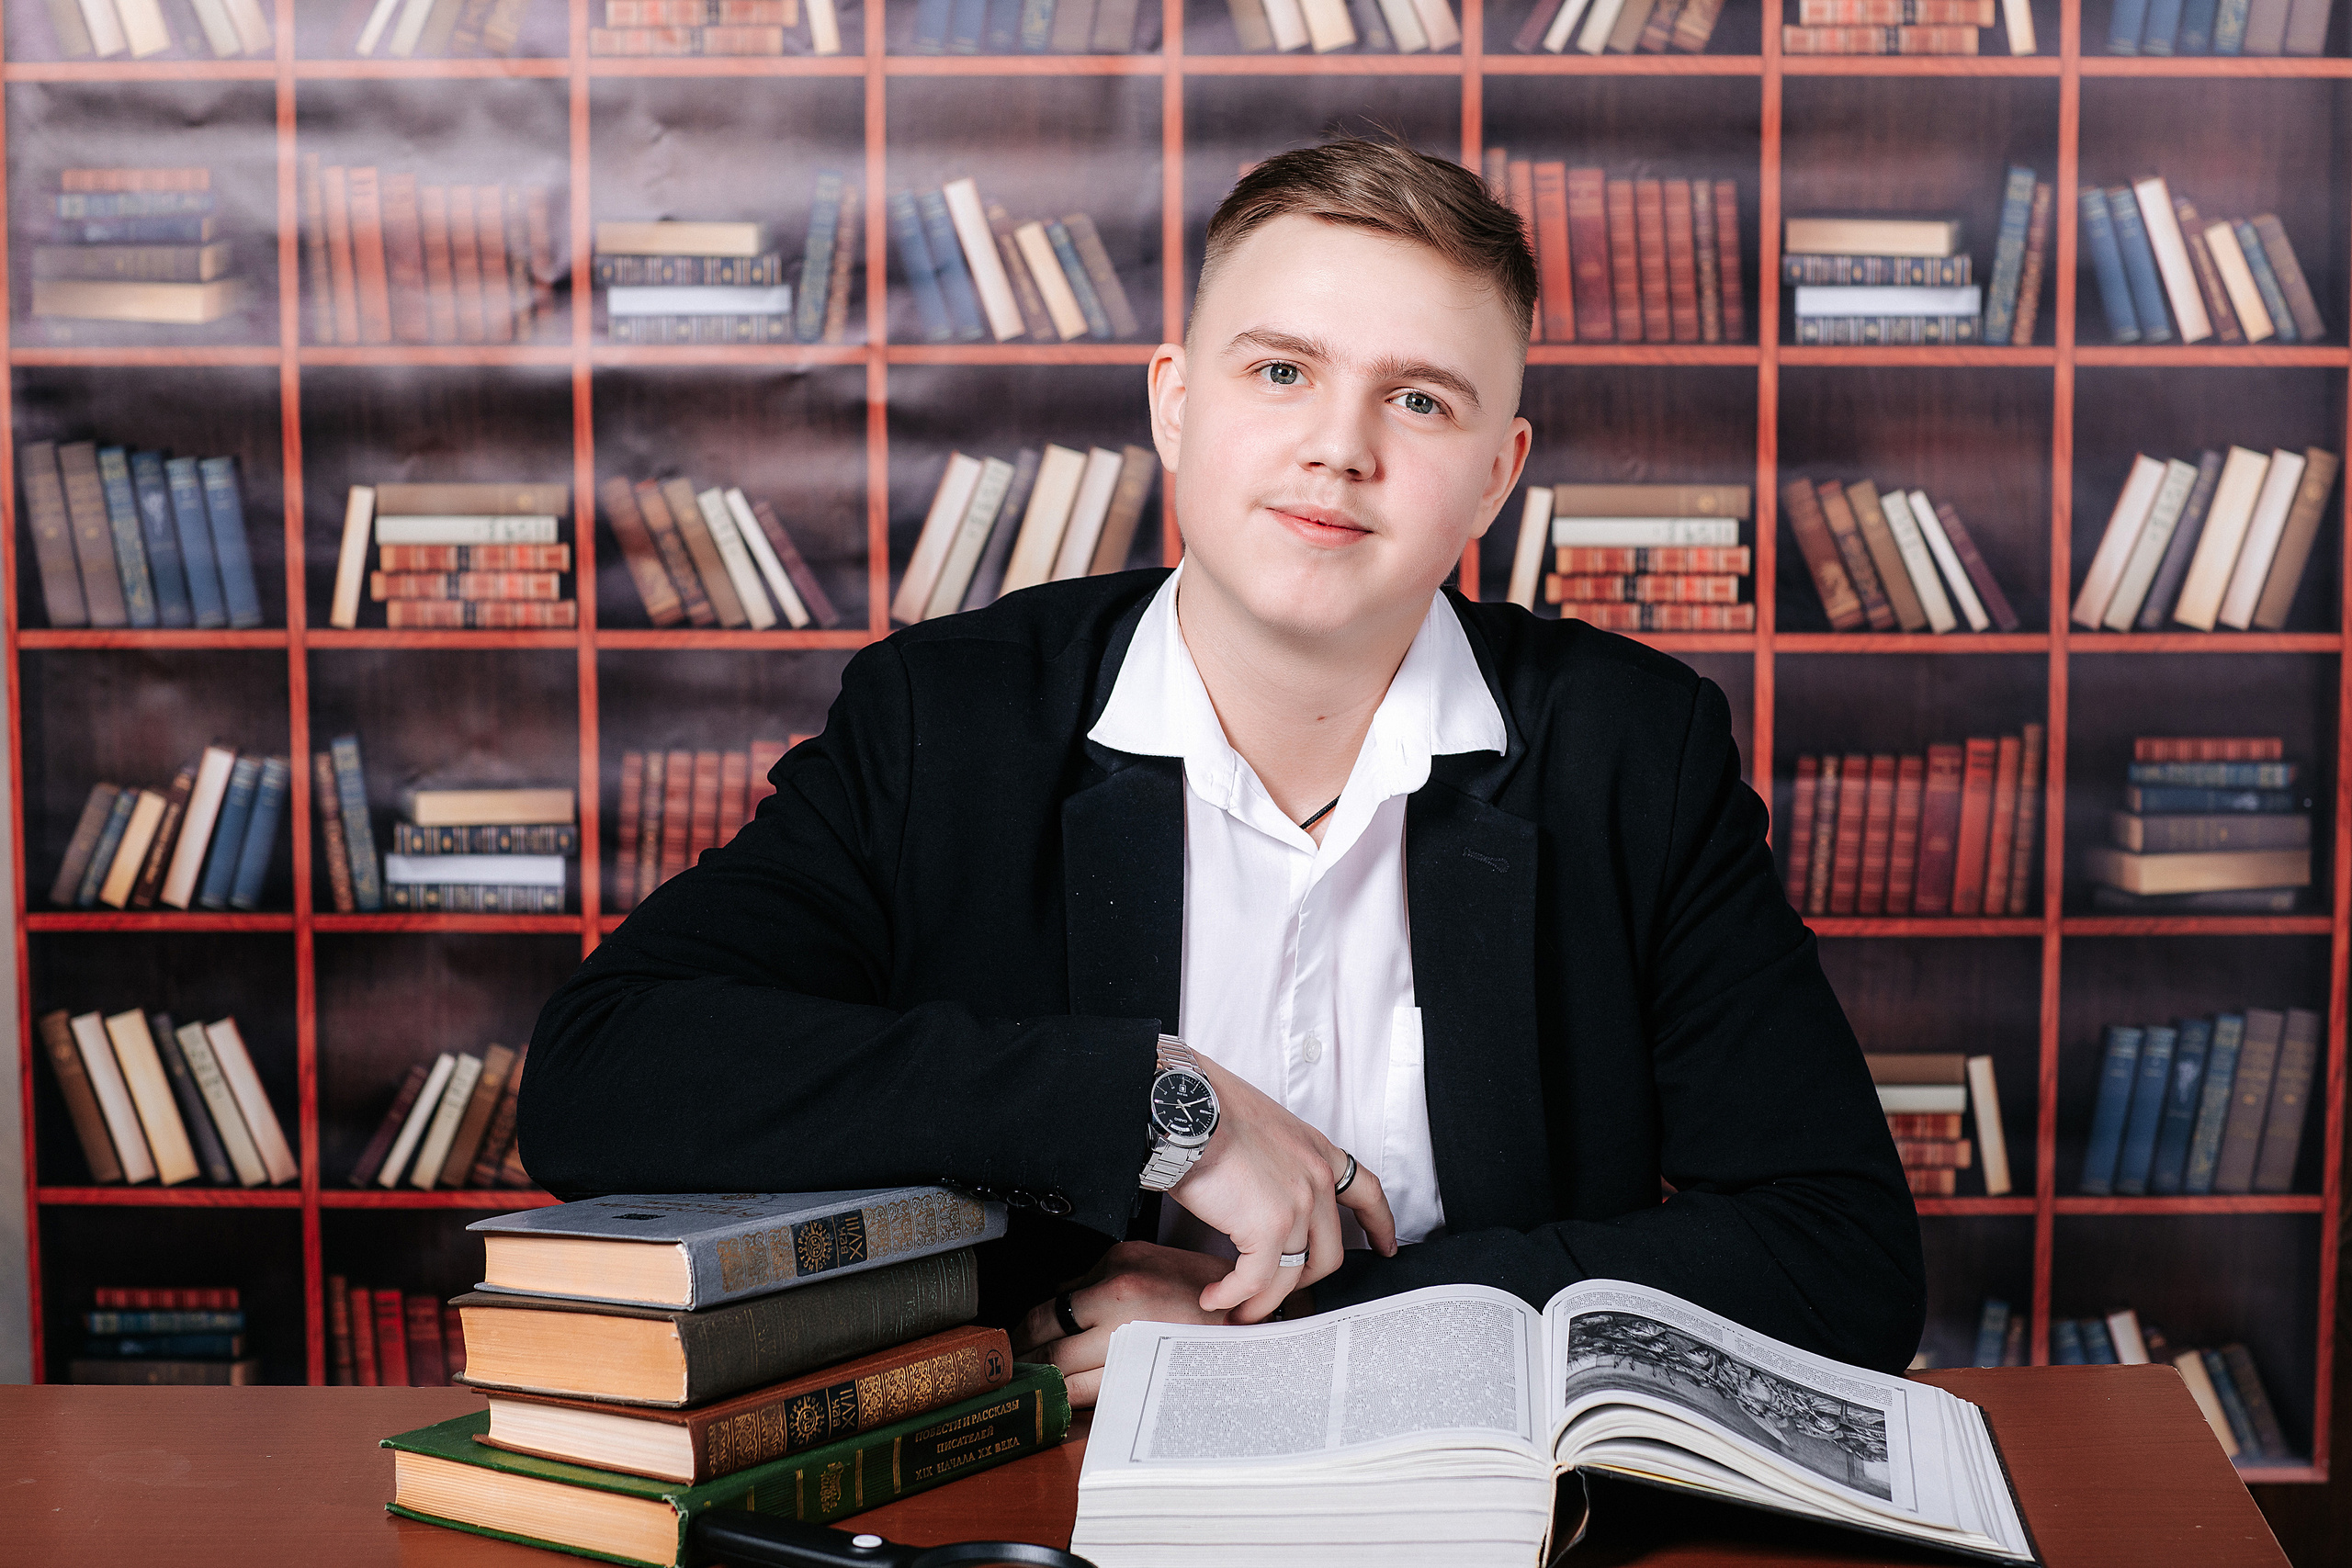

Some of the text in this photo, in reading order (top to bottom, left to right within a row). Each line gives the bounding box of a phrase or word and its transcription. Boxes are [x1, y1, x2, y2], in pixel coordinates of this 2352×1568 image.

[797, 1224, 814, 1271] ИСТОРИЯ
[845, 1216, 864, 1260] XVIII
[840, 1388, 856, 1430] XVII
[915, 1399, 1020, 1442] ПОВЕСТИ И РАССКАЗЫ
[915, 1437, 1020, 1481] XIX НАЧАЛА XX ВЕКА
[936, 1425, 994, 1454] ПИСАТЕЛЕЙ
